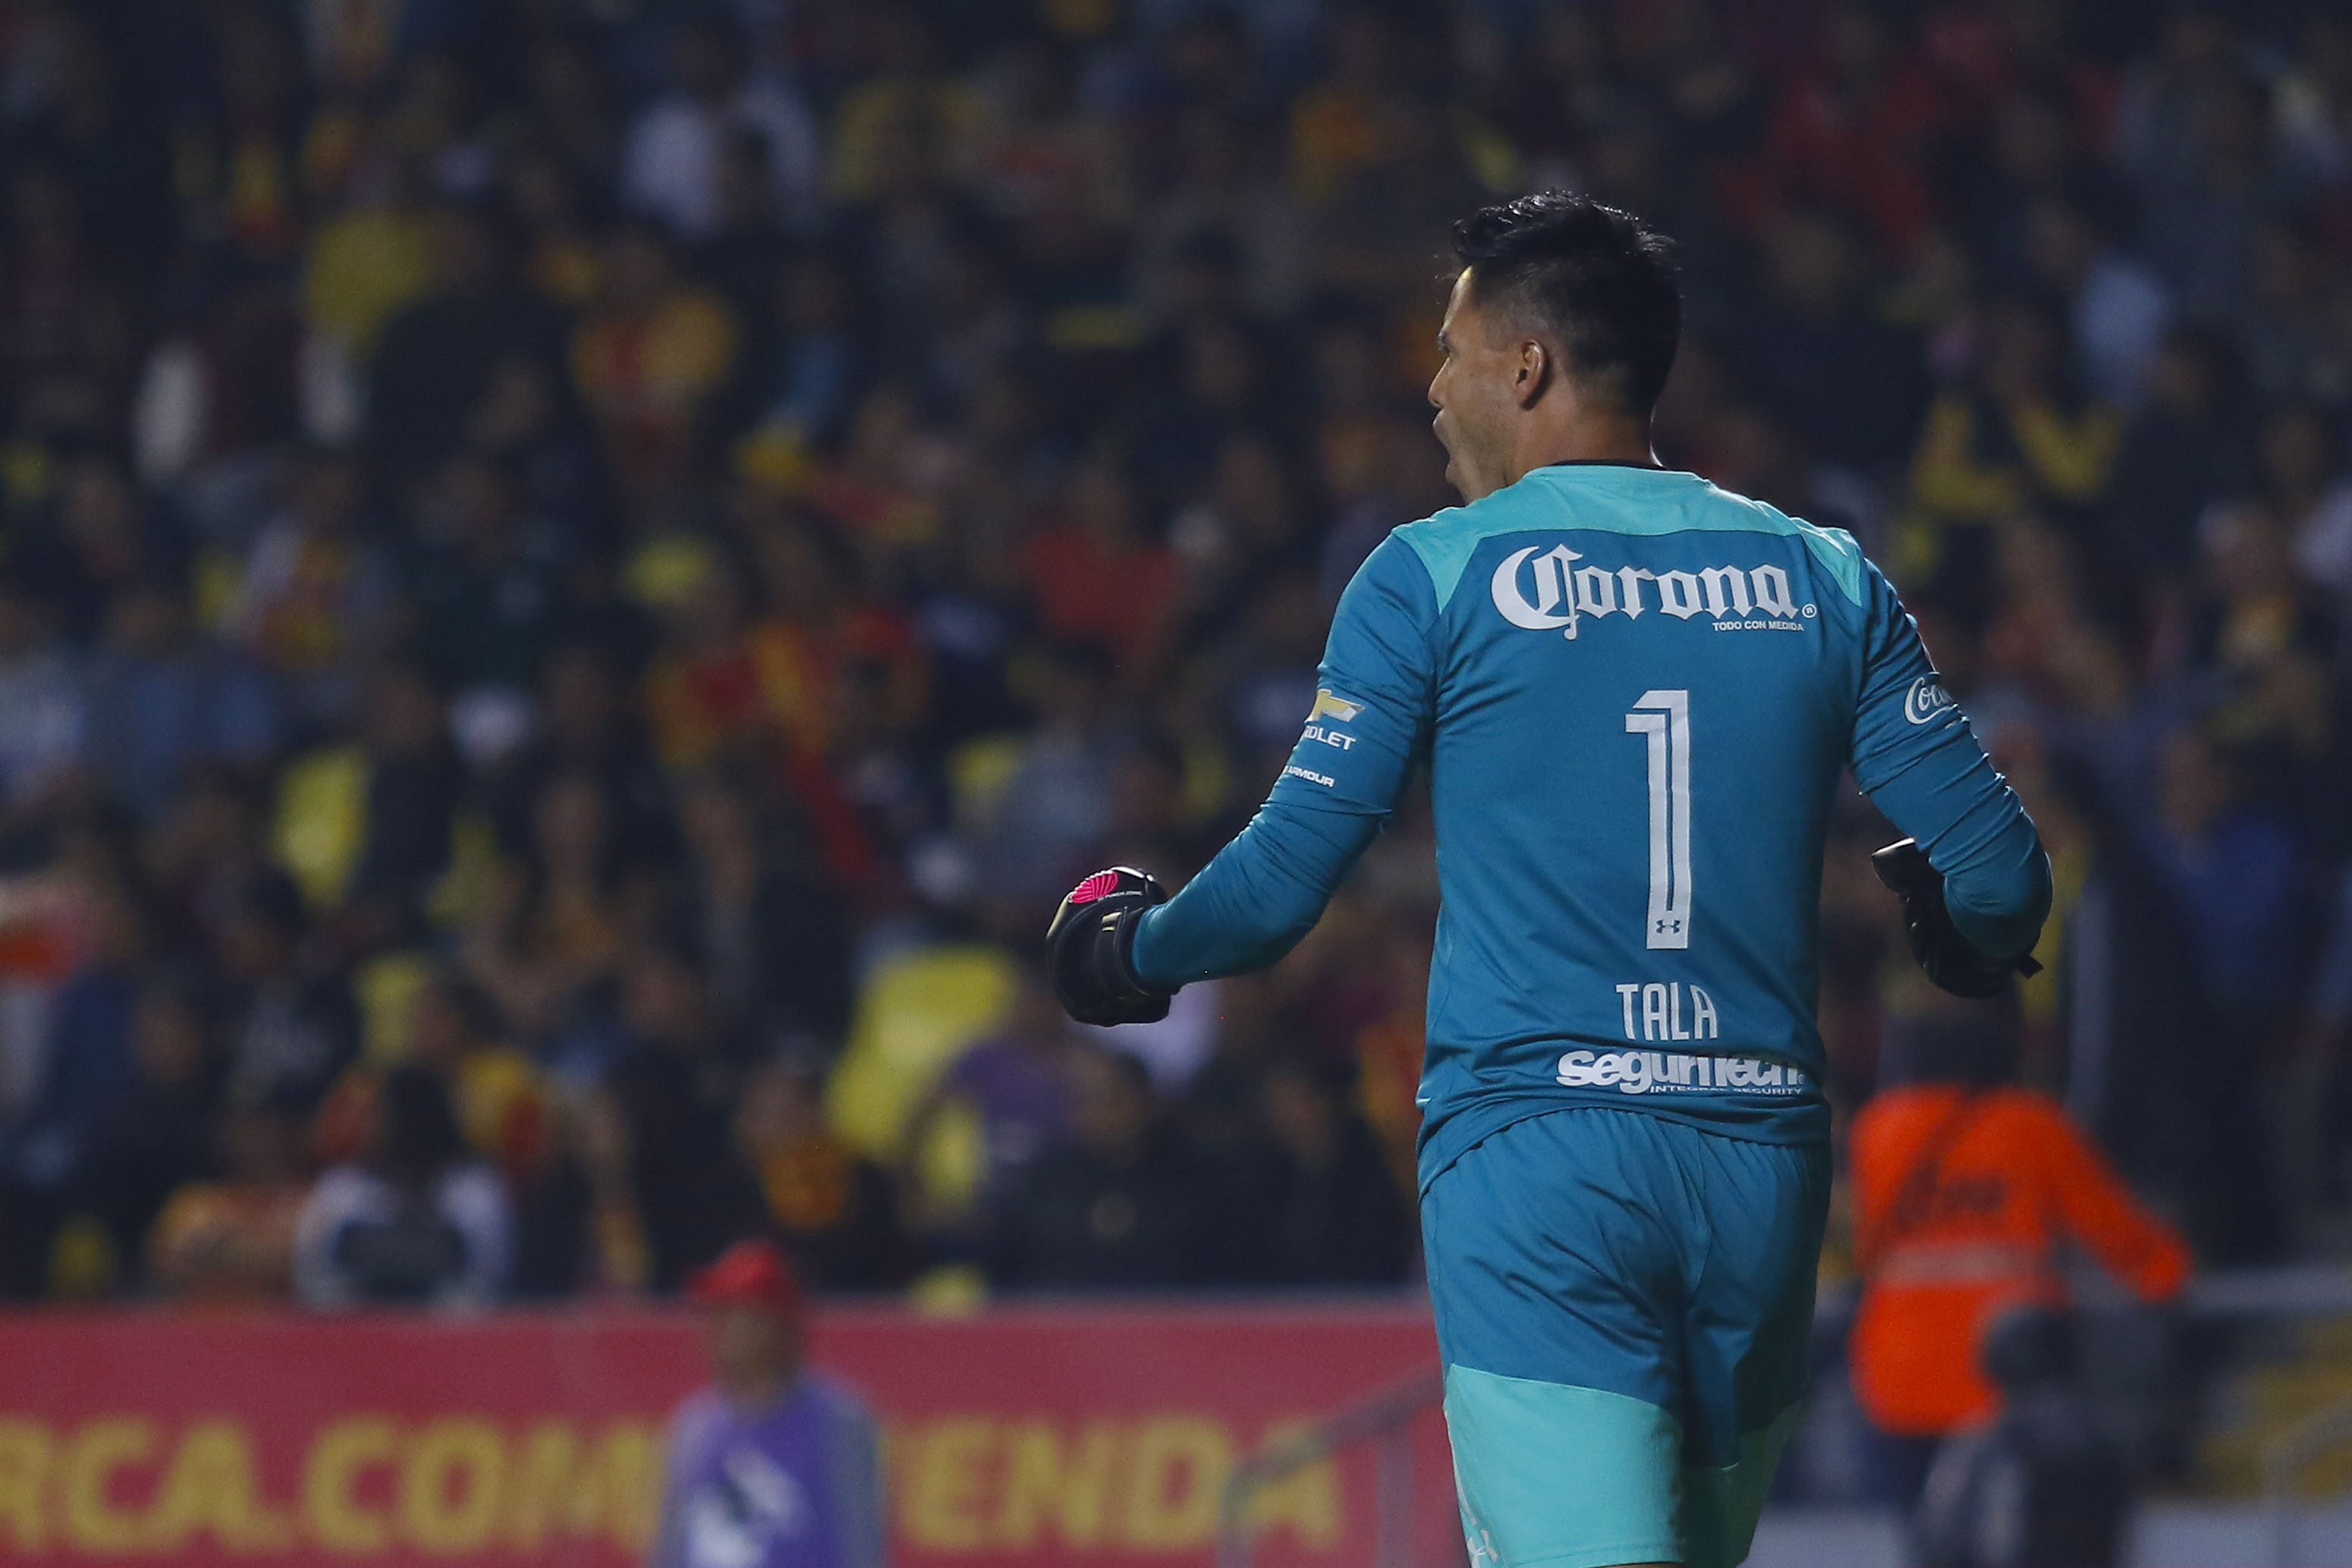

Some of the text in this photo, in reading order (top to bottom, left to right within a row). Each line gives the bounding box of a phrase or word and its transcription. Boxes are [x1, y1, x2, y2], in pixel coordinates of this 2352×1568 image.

[1491, 543, 1799, 640] Corona
[1712, 621, 1804, 632] TODO CON MEDIDA
[1288, 765, 1335, 787] ARMOUR
[1625, 689, 1691, 950] 1
[1615, 982, 1718, 1042] TALA
